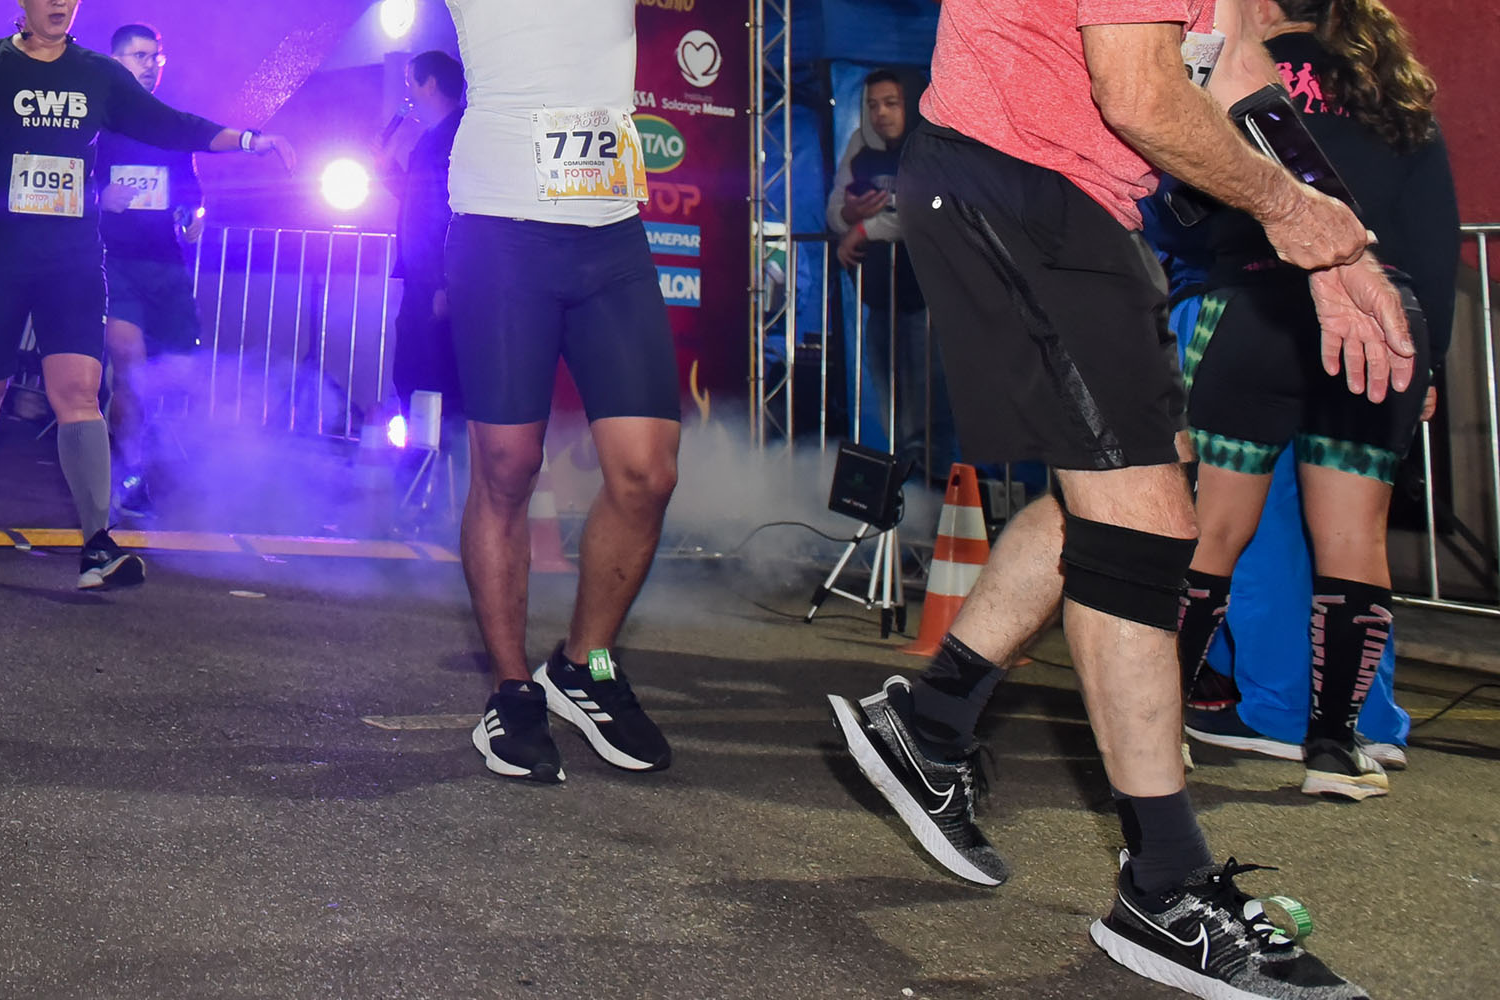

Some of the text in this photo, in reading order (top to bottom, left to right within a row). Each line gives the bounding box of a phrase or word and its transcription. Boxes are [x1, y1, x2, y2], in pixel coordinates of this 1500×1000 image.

[13, 89, 89, 118] CWB
[661, 98, 736, 117] Solange Massa
[22, 117, 80, 129] RUNNER
[546, 131, 618, 159] 772
[19, 170, 74, 190] 1092
[646, 231, 701, 248] ANEPAR
